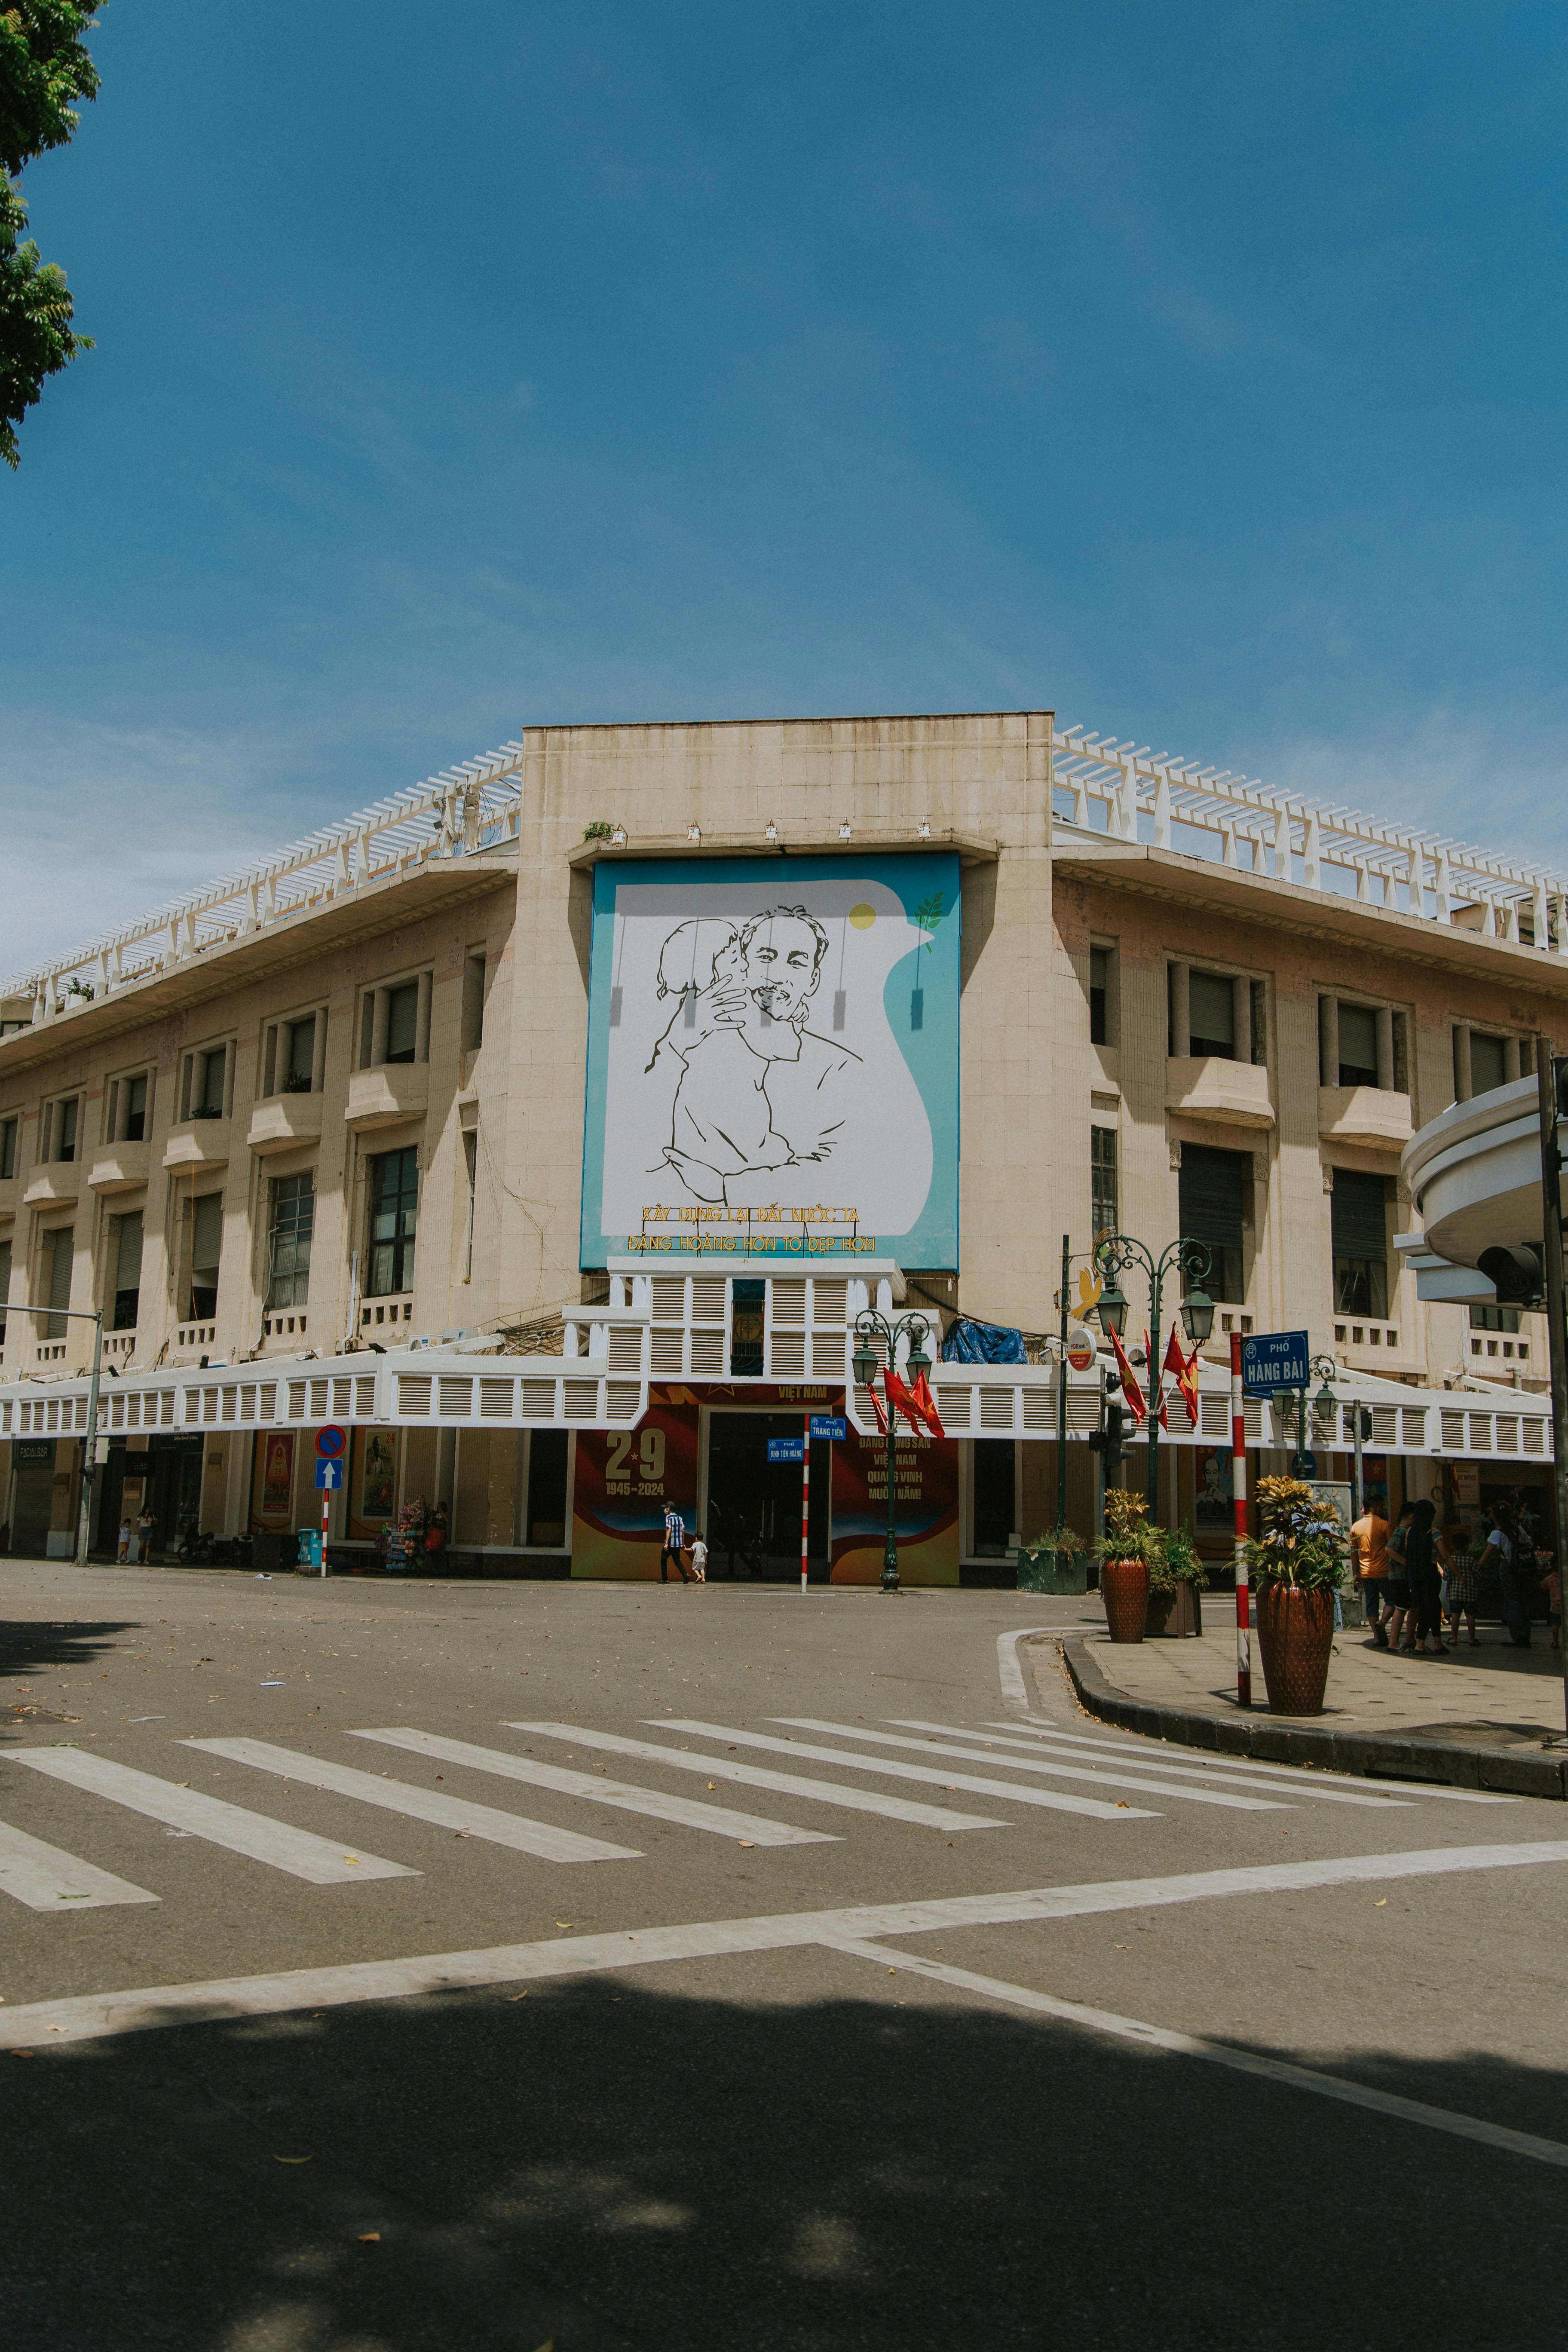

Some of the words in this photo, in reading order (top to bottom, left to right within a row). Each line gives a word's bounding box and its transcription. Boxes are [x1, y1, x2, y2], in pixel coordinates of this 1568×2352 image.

[641, 1203, 671, 1221] XÂY
[679, 1206, 722, 1225] DỰNG
[728, 1207, 749, 1225] LẠI
[757, 1202, 784, 1222] ĐẤT
[792, 1204, 836, 1222] NƯỚC
[842, 1208, 860, 1222] TA
[628, 1231, 672, 1250] ĐÀNG
[680, 1232, 736, 1251] HOÀNG
[744, 1235, 776, 1251] HƠN
[783, 1237, 802, 1251] TO
[807, 1237, 835, 1255] ĐẸP
[842, 1236, 875, 1252] HƠN
[1270, 1338, 1290, 1353] PHỐ
[1248, 1360, 1280, 1382] HÀNG
[1283, 1357, 1303, 1379] BÀI
[779, 1384, 802, 1401] VIỆT
[804, 1386, 827, 1398] NAM
[813, 1426, 830, 1436] TRÀNG
[832, 1427, 843, 1436] TIỀN
[790, 1448, 802, 1458] HOÀNG
[874, 1452, 888, 1468] VIỆ
[896, 1454, 916, 1465] NAM
[867, 1471, 899, 1483] QUAG
[900, 1471, 922, 1482] VINH
[869, 1486, 895, 1499] MUÔ
[897, 1486, 921, 1499] NĂM!
